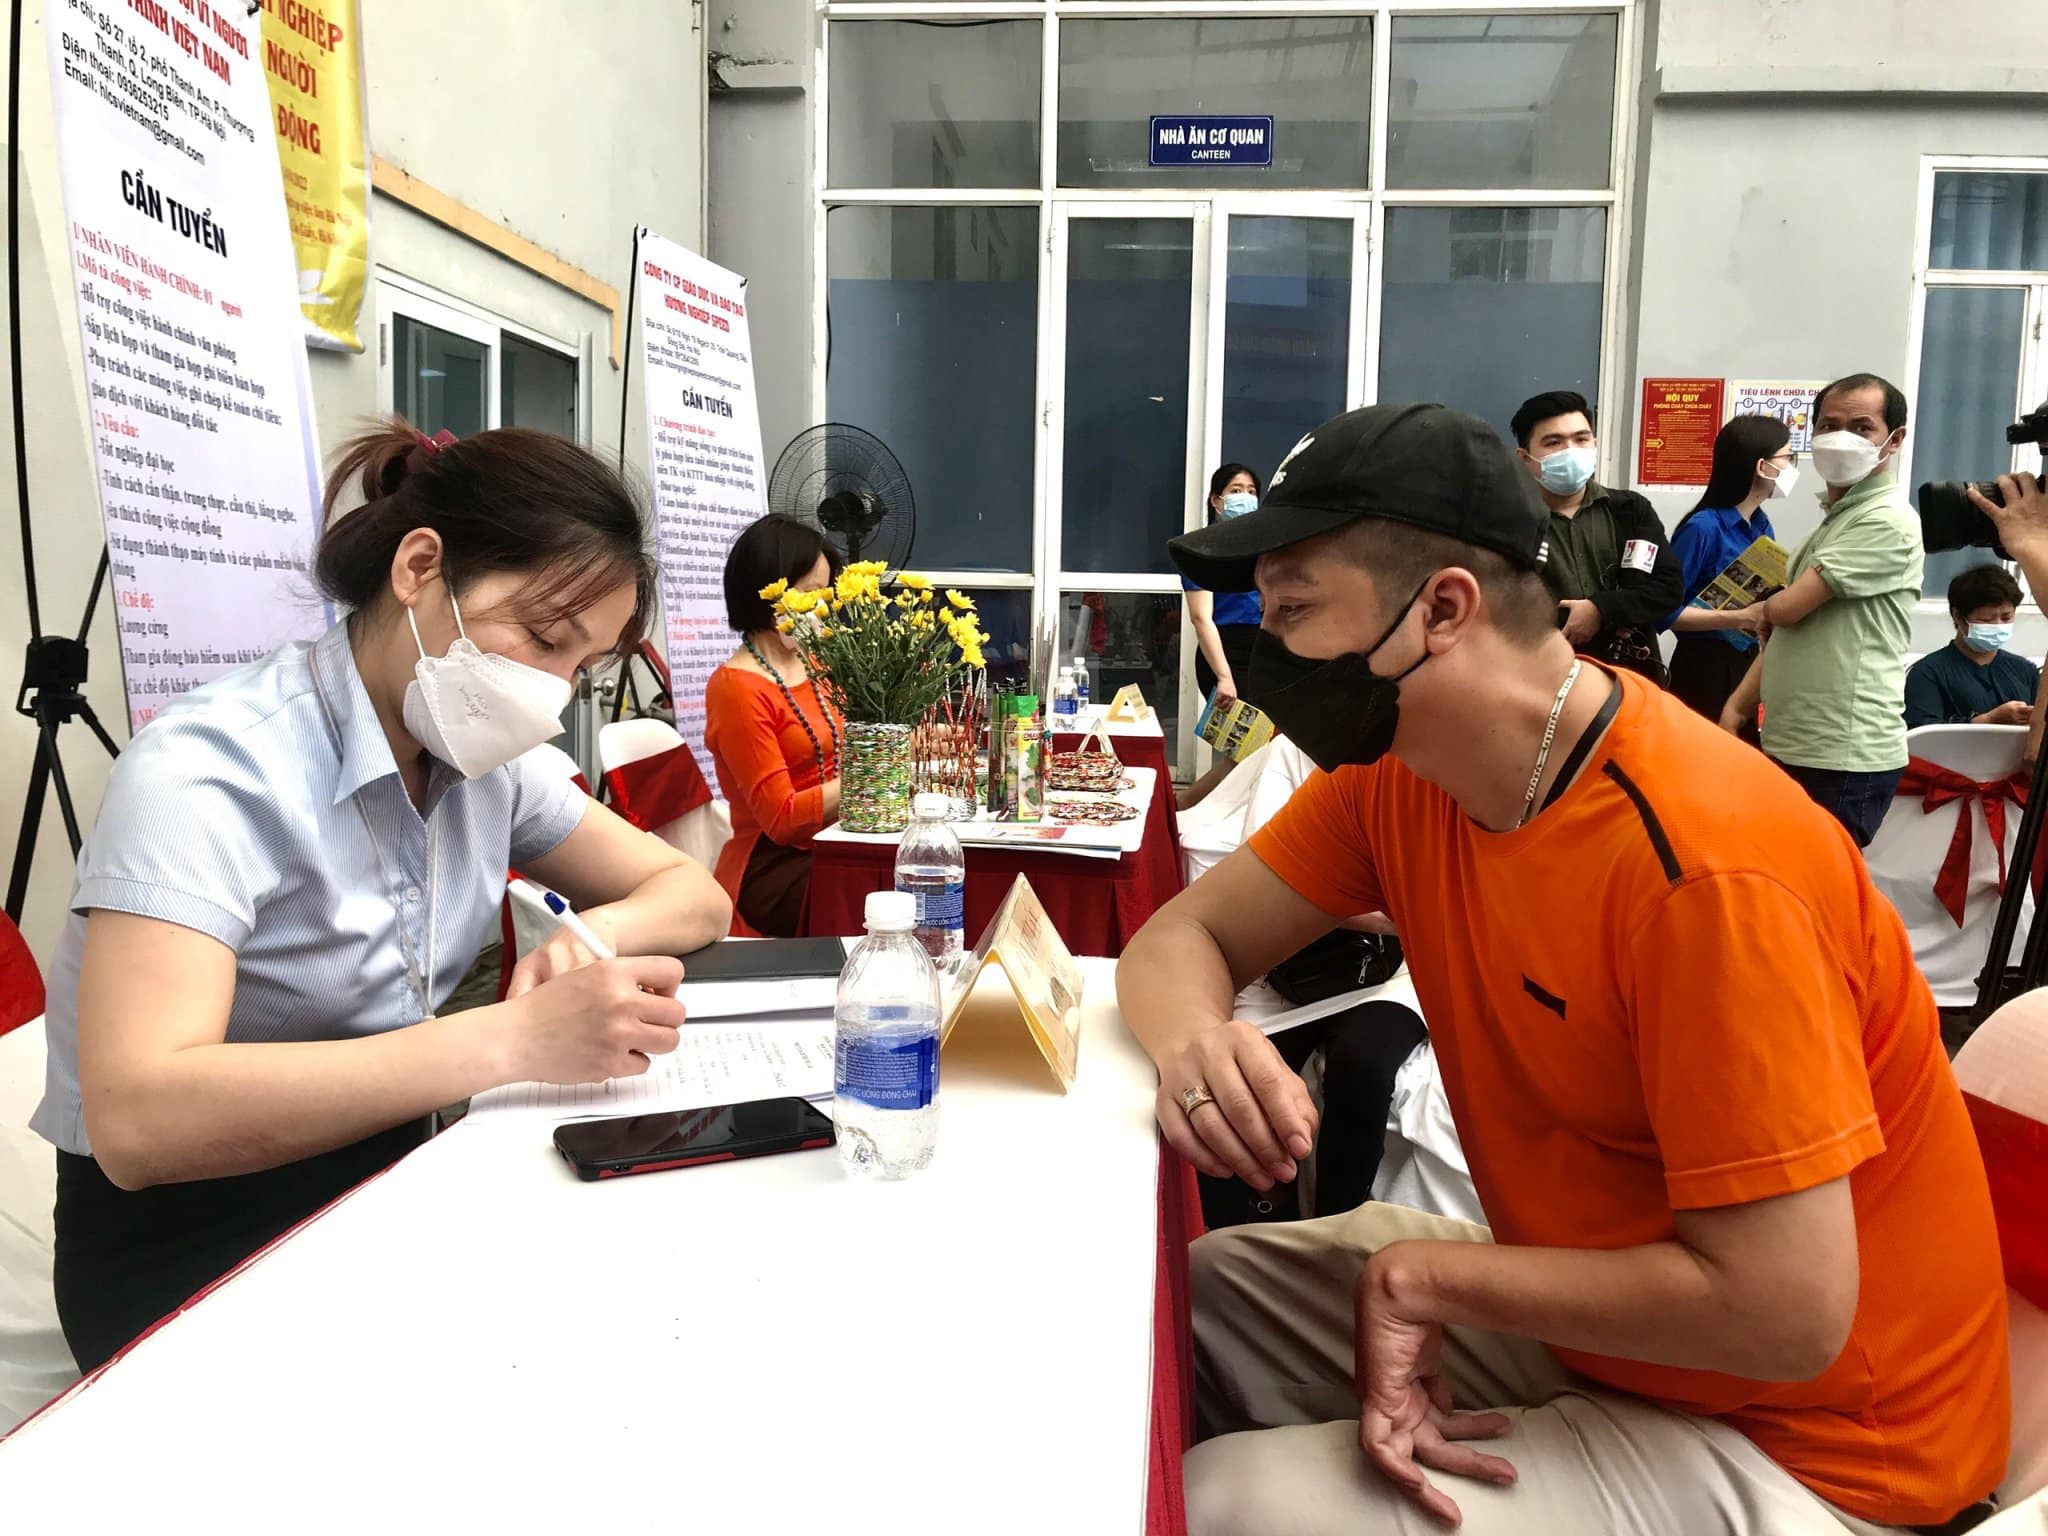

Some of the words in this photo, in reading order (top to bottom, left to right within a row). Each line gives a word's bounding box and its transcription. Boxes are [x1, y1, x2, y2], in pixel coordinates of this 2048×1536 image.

[99, 12, 112, 35] Số
[62, 31, 88, 63] Điện
[90, 51, 115, 84] thoại:
[94, 32, 127, 72] Thanh,
[140, 67, 164, 100] Long
[171, 15, 199, 60] VIỆT
[202, 42, 231, 86] NAM
[64, 56, 98, 94] Email:
[278, 102, 321, 155] ĐỘNG
[1160, 125, 1186, 144] NHÀ
[1188, 126, 1206, 144] ĂN
[1209, 128, 1228, 144] CƠ
[1230, 128, 1264, 146] QUAN
[1192, 150, 1231, 159] CANTEEN
[166, 196, 228, 258] TUYỂN
[113, 299, 134, 324] công
[1682, 394, 1700, 402] QUY
